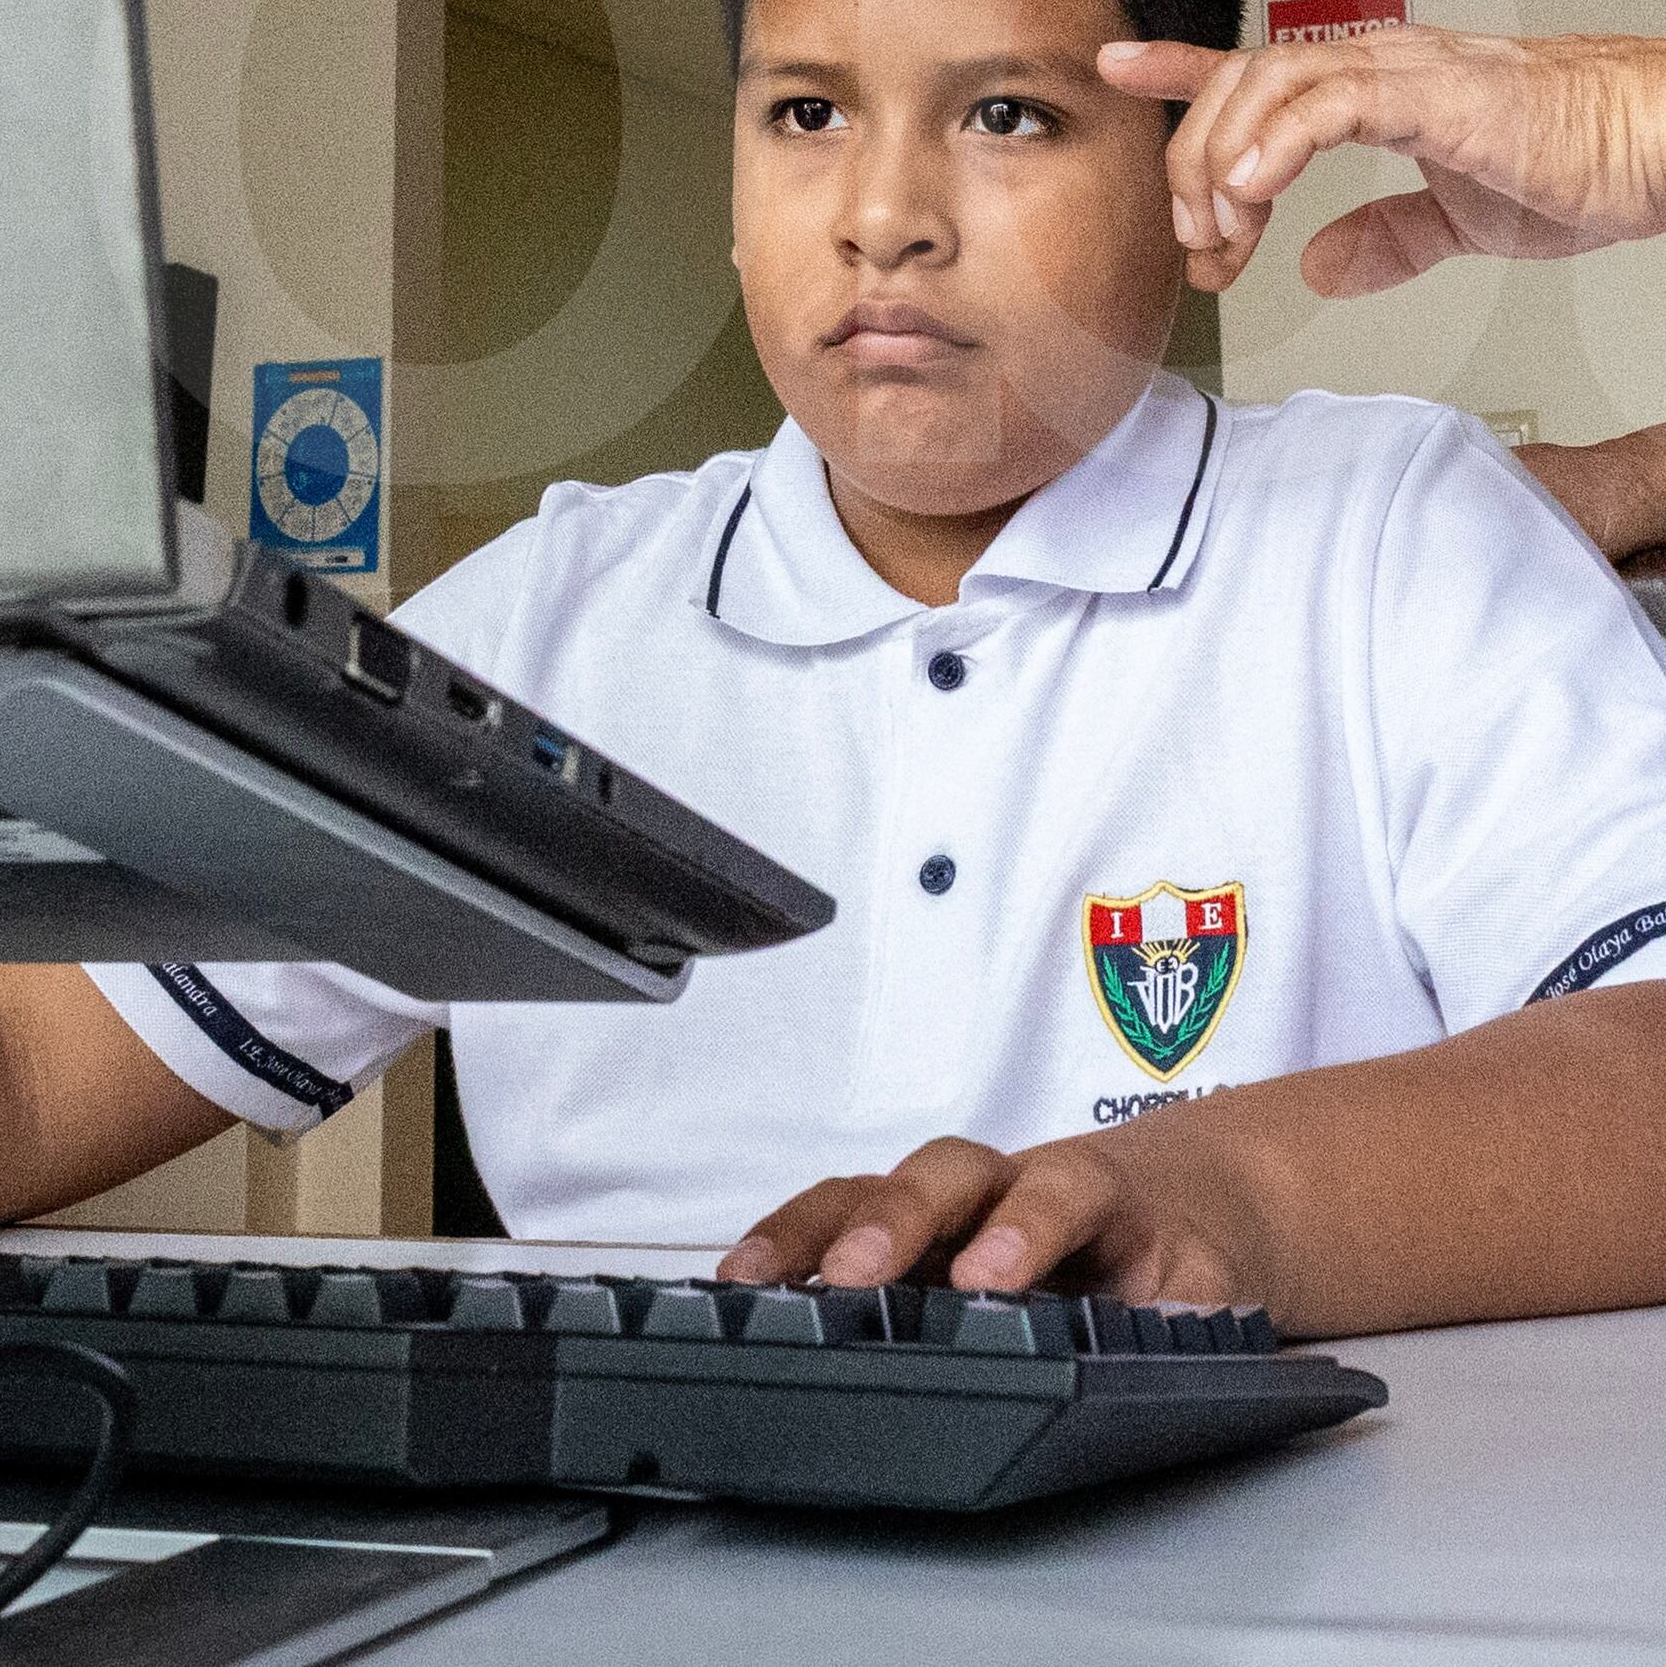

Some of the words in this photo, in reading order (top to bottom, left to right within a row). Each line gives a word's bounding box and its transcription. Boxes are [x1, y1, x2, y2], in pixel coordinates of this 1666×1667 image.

[1109, 911, 1124, 939] I
[1199, 902, 1224, 931] E
[1578, 928, 1633, 971] Olaya
[162, 961, 218, 1017] alandra
